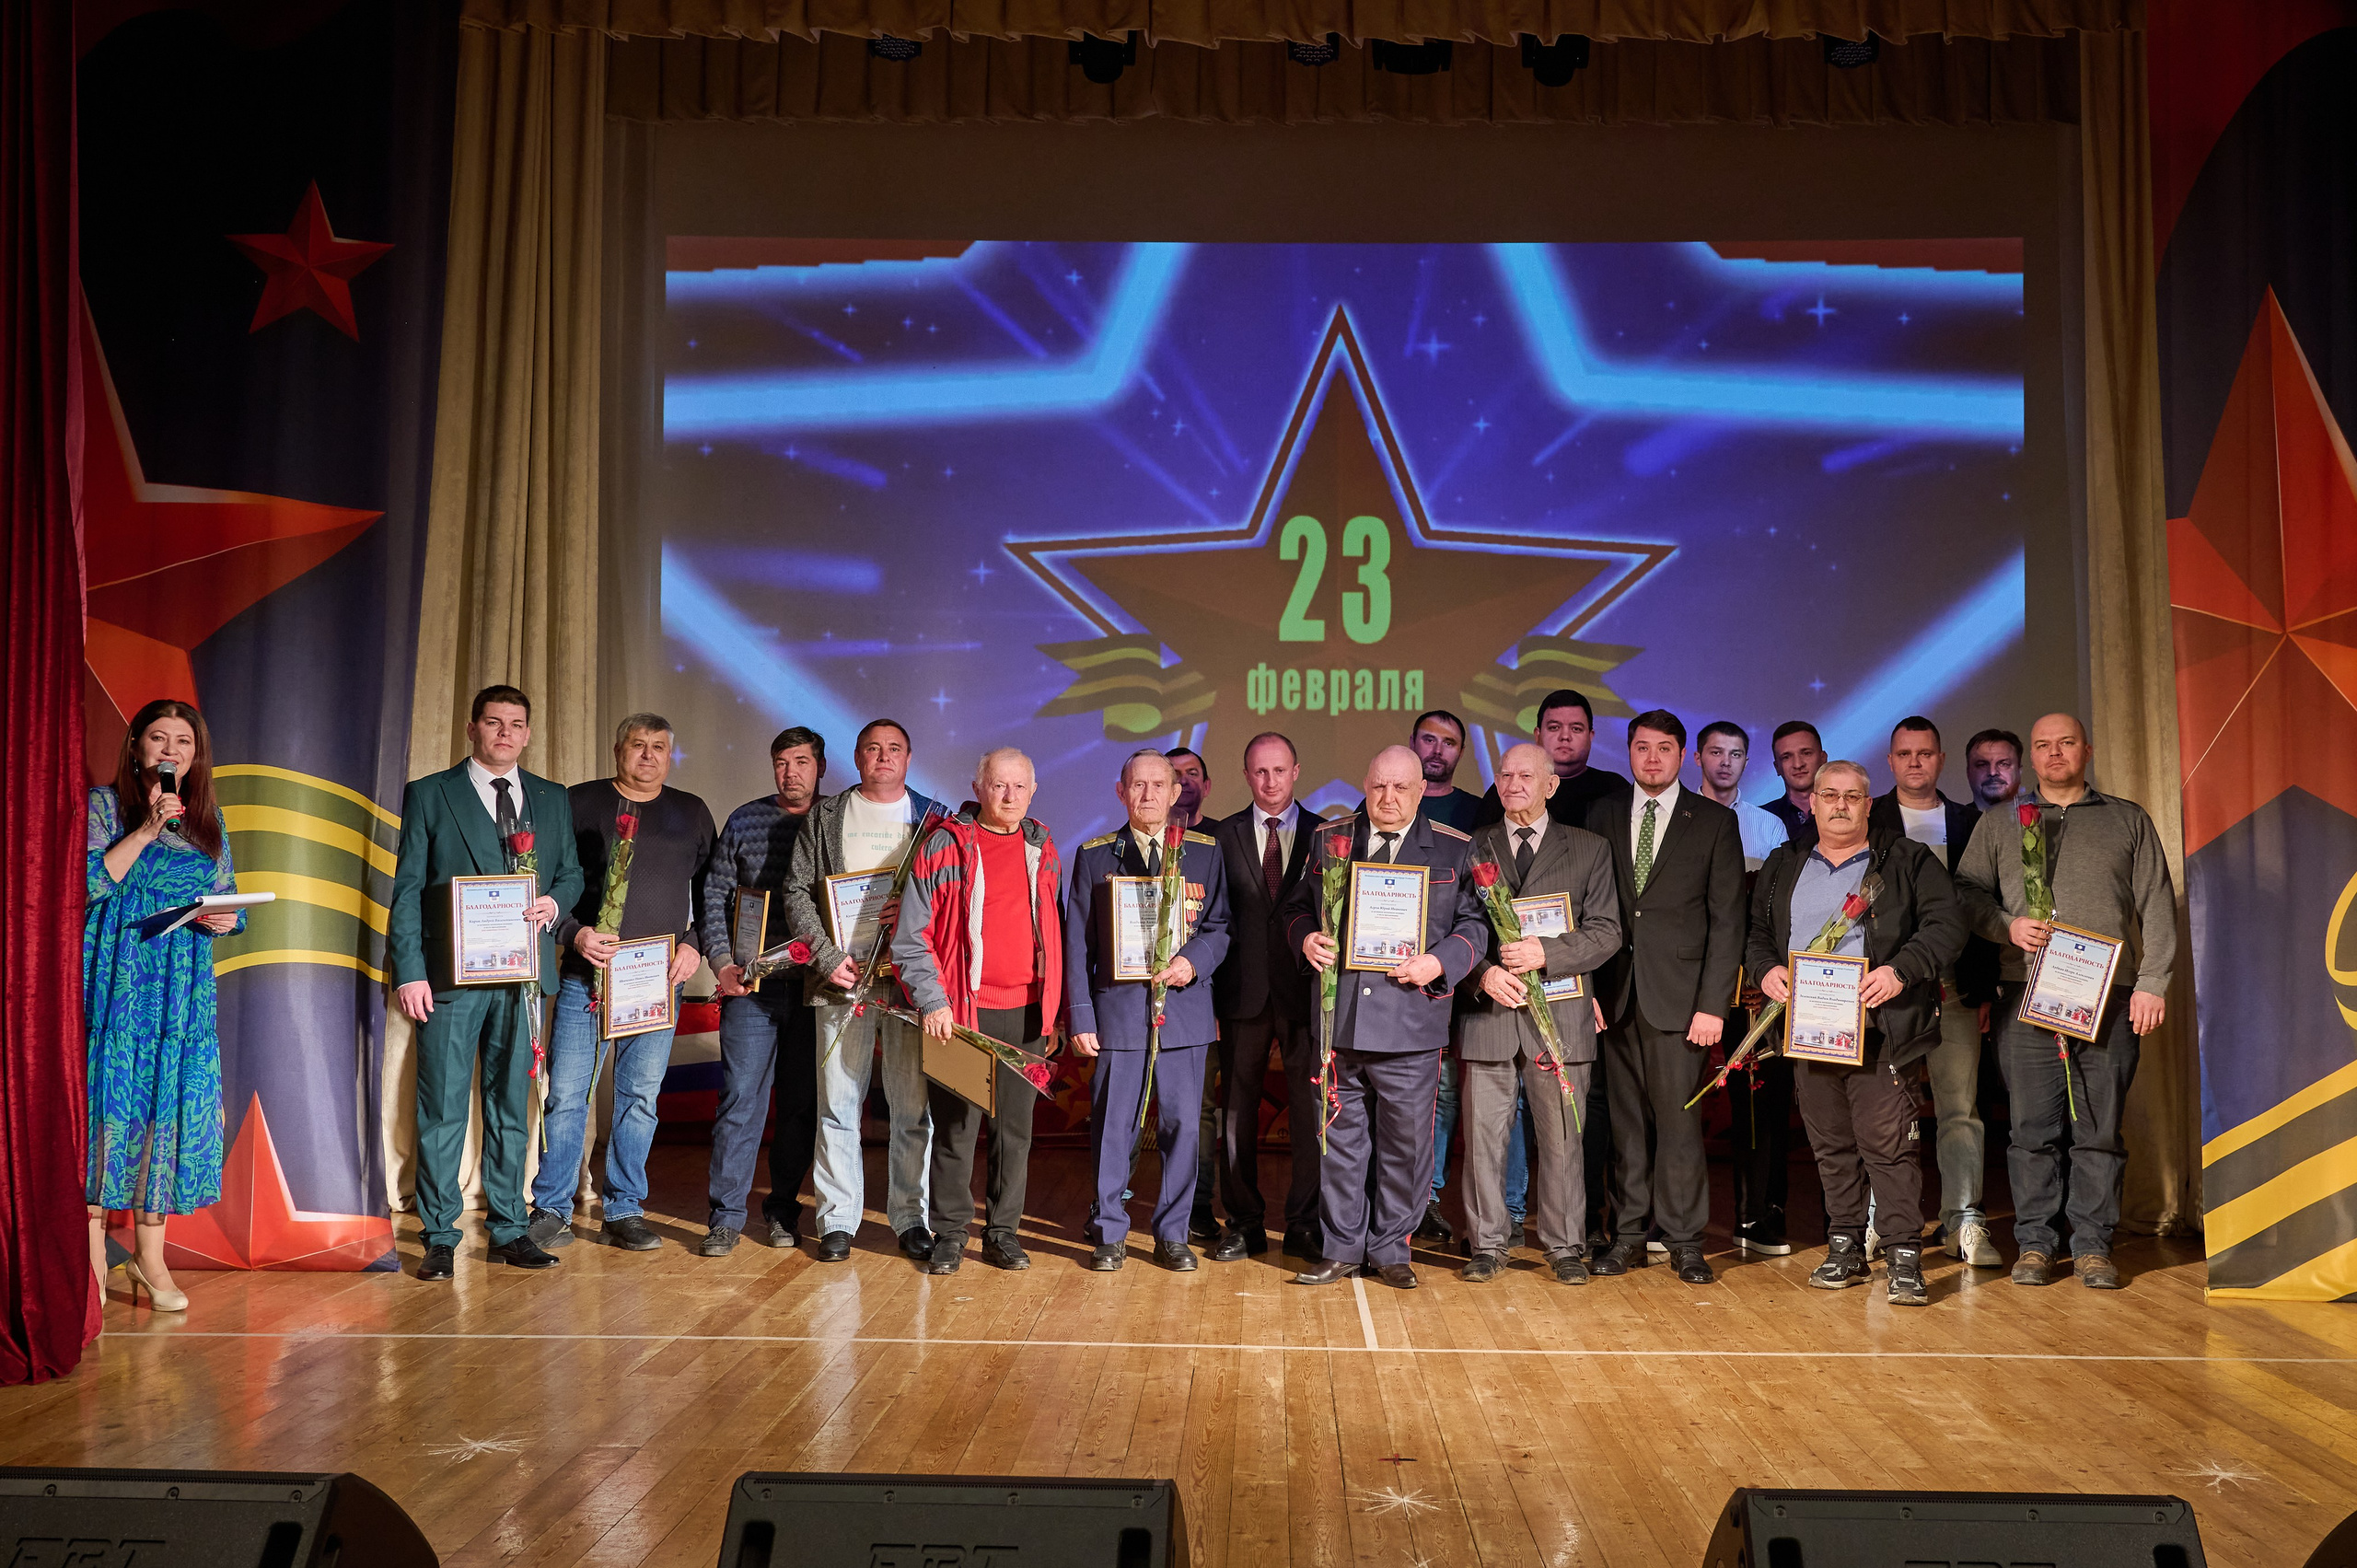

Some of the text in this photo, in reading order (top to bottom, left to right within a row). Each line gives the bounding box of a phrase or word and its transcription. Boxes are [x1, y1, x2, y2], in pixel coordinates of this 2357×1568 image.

[1279, 515, 1391, 644] 23
[1247, 662, 1424, 716] февраля
[841, 894, 888, 906] БЛАГОДАРНОСТ
[1362, 890, 1417, 899] БЛАГОДАРНОСТЬ
[465, 902, 524, 911] БЛАГОДАРНОСТЬ
[2049, 949, 2104, 970] БЛАГОДАРНОСТЬ
[614, 960, 664, 971] БЛАГОДАРНОСТЬ
[1800, 979, 1856, 990] БЛАГОДАРНОСТЬ
